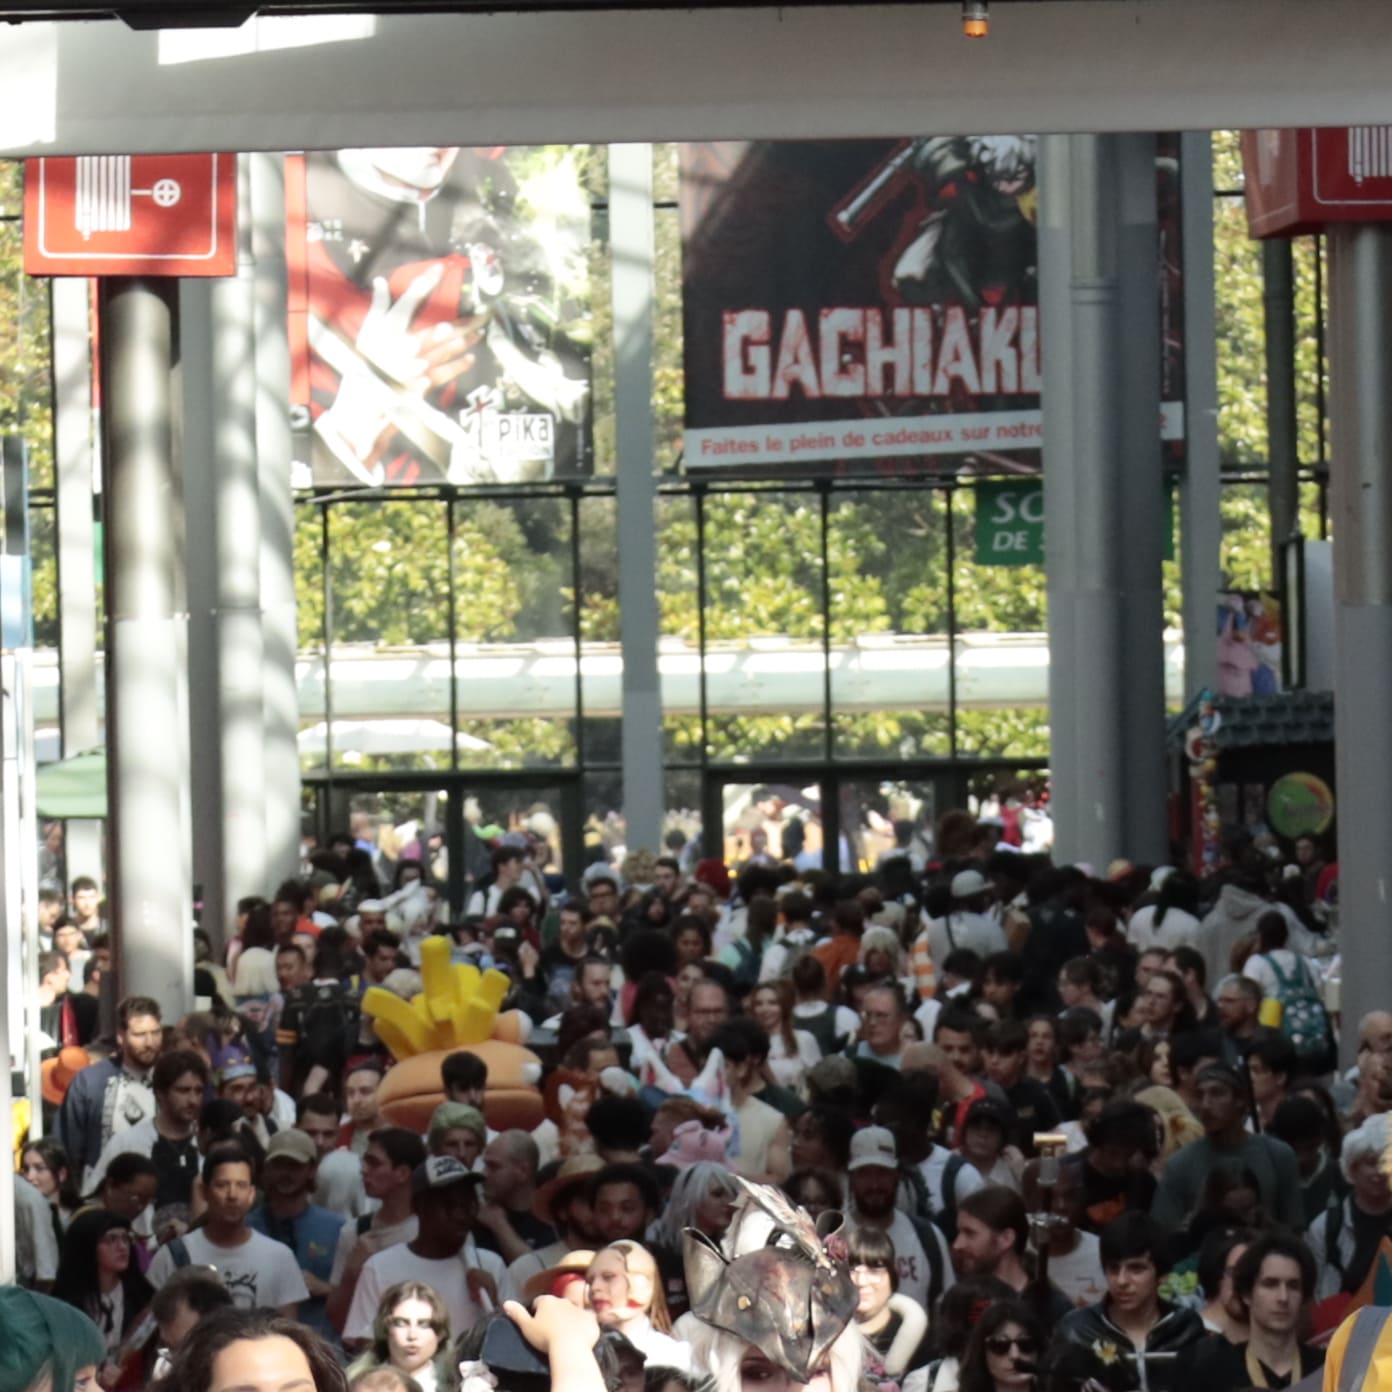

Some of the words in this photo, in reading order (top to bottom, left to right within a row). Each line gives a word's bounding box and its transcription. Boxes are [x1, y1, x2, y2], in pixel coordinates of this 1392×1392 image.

[701, 438, 759, 456] Faites
[766, 435, 783, 452] le
[789, 434, 835, 456] plein
[842, 431, 865, 448] de
[872, 427, 953, 447] cadeaux
[961, 426, 990, 441] sur
[992, 530, 1029, 552] DE
